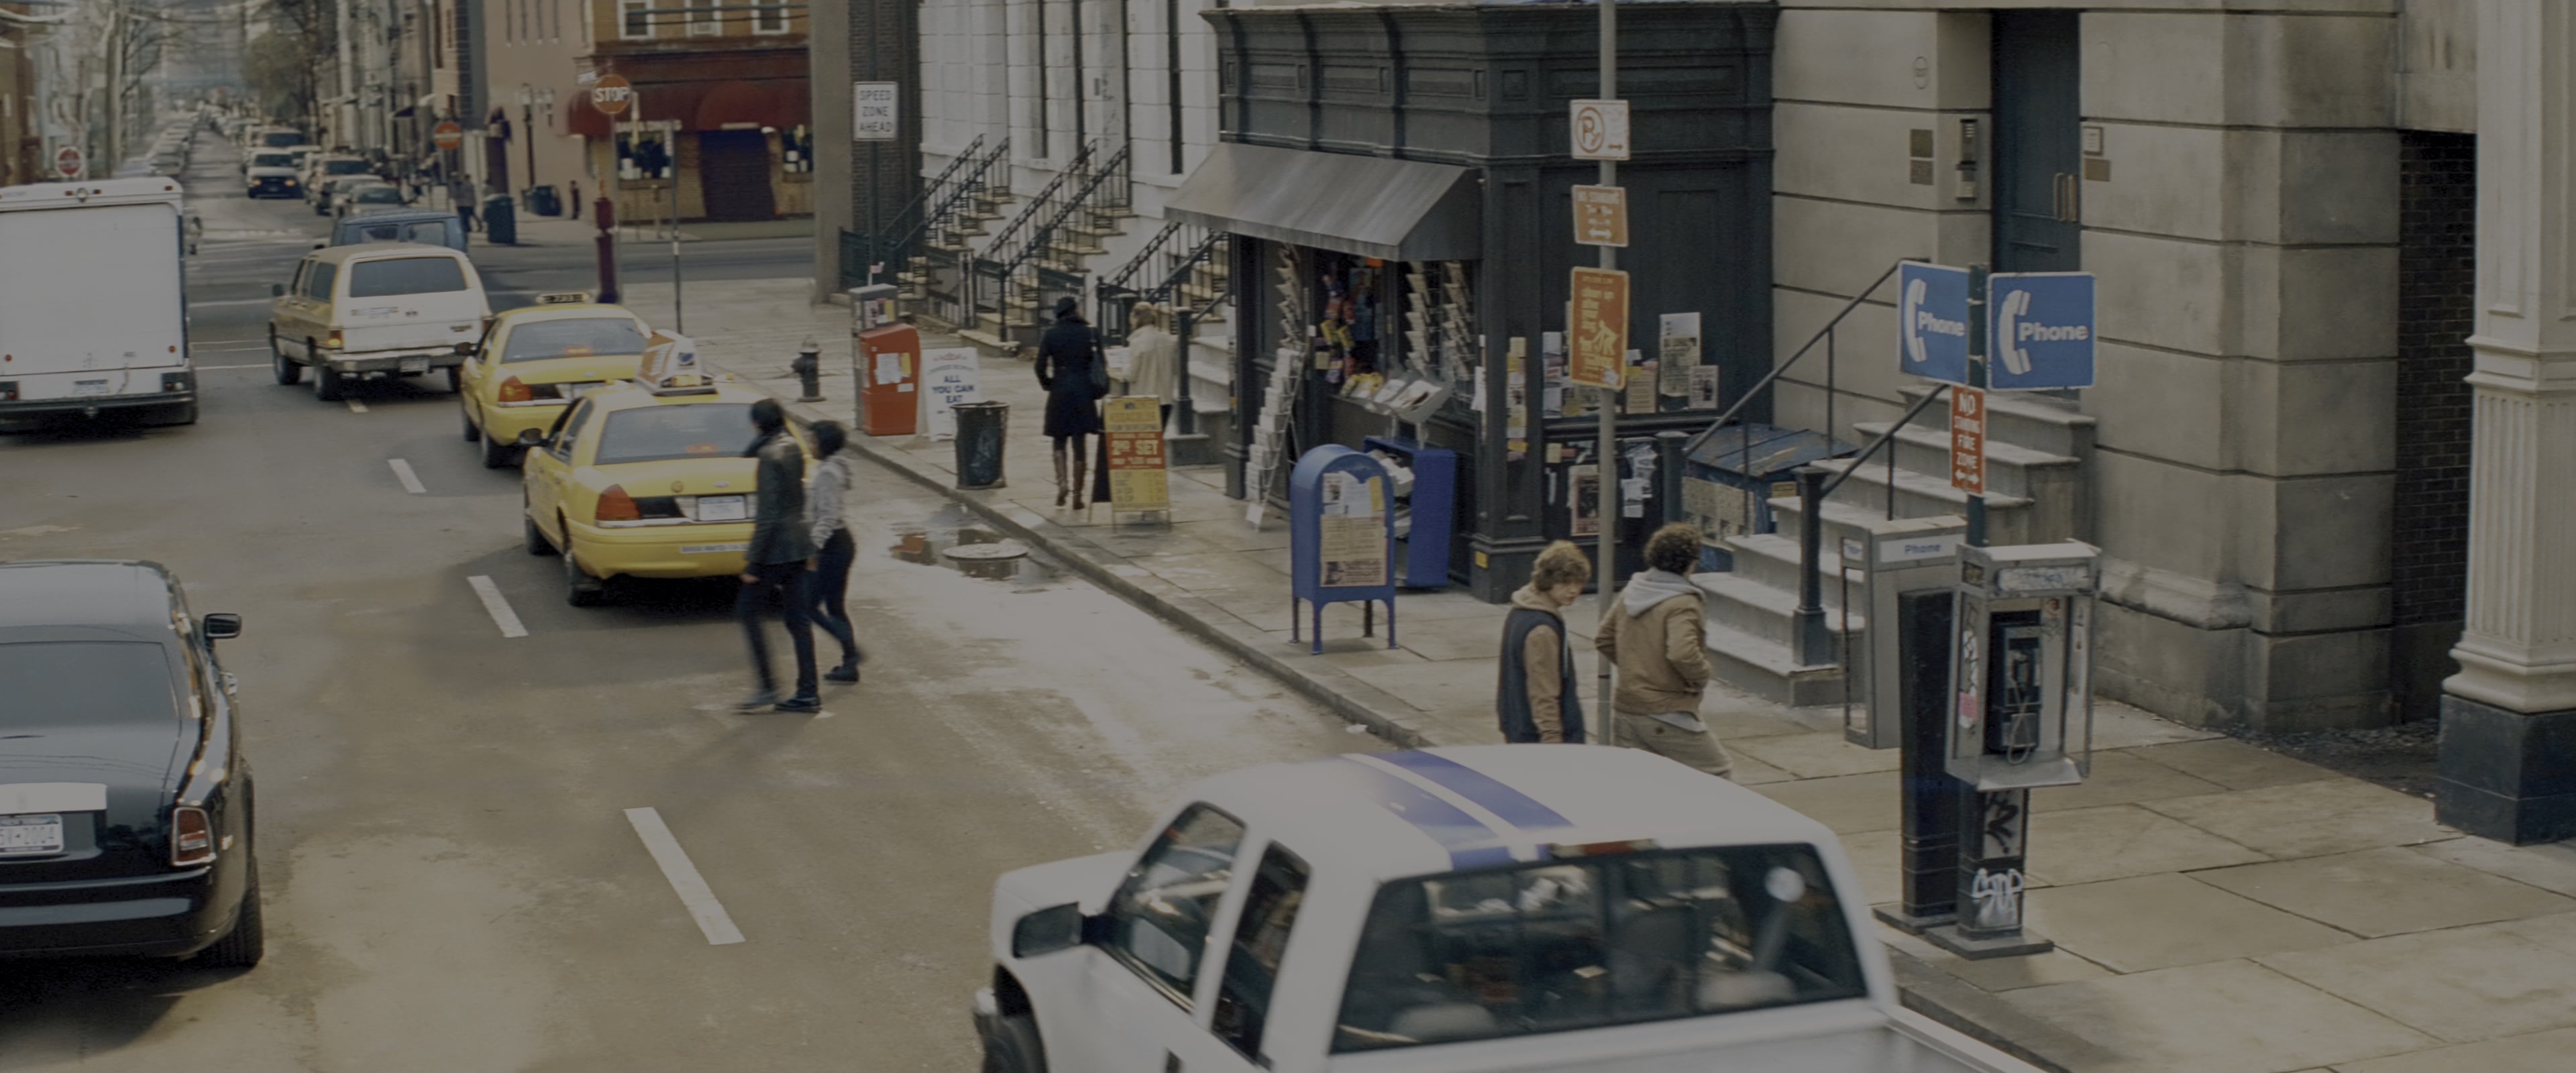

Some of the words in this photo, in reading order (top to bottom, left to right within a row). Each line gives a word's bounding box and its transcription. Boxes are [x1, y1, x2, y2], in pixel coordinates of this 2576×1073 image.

[594, 87, 629, 102] STOP
[859, 90, 892, 101] SPEED
[862, 106, 889, 117] ZONE
[859, 121, 892, 132] AHEAD
[1917, 310, 1965, 337] Phone
[2017, 321, 2088, 342] Phone
[954, 384, 975, 393] CAN
[946, 395, 963, 403] EAT
[1958, 392, 1978, 416] NO
[1134, 439, 1159, 456] SET
[1957, 434, 1977, 451] FIRE
[1956, 451, 1978, 469] ZONE
[1904, 544, 1941, 555] Phone
